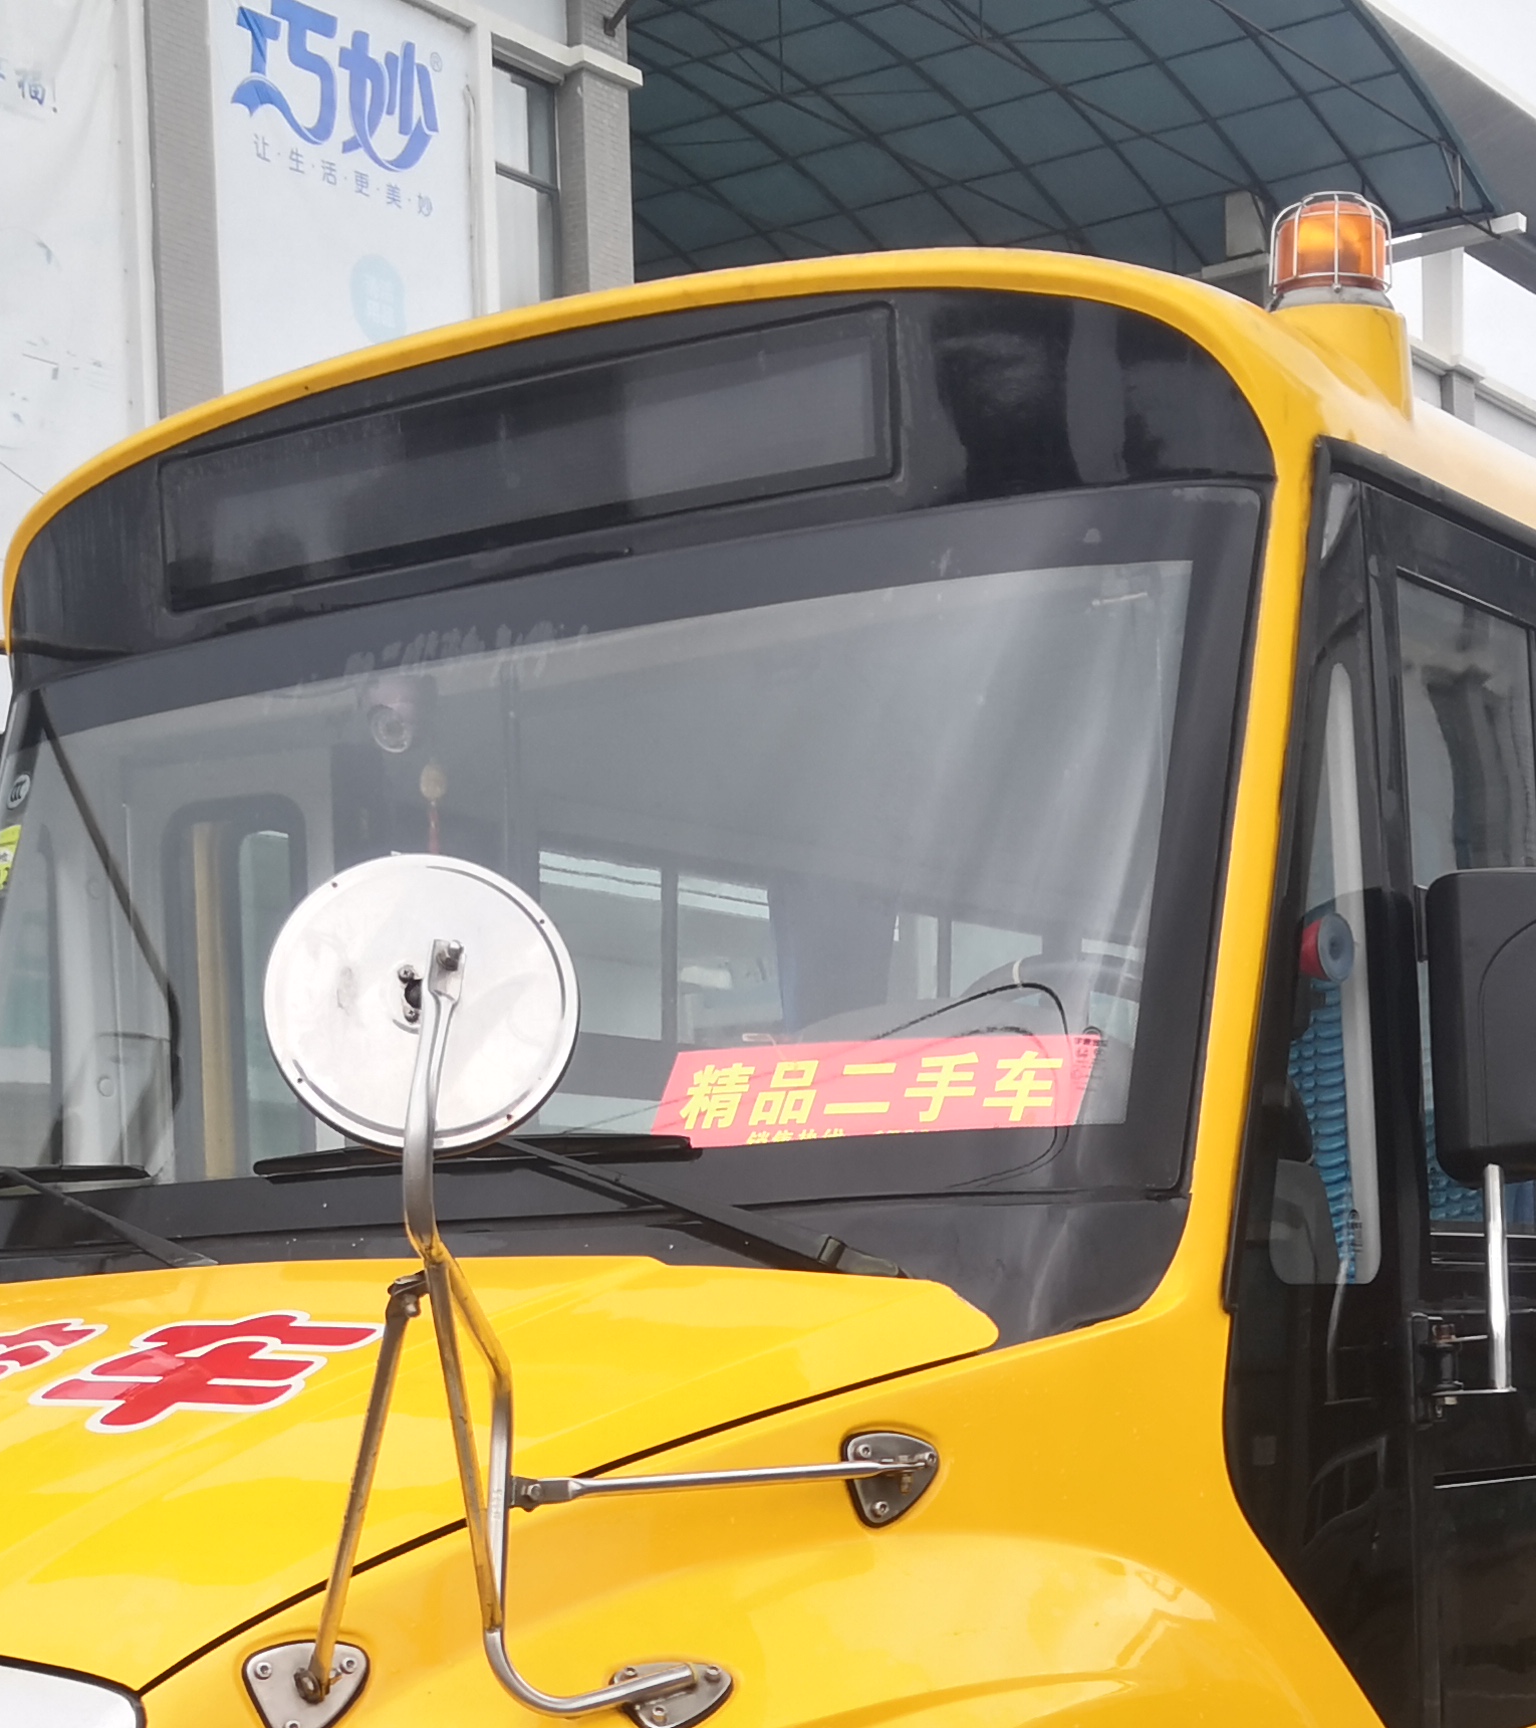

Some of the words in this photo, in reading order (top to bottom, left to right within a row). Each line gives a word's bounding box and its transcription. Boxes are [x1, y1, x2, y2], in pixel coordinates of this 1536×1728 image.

[680, 1051, 1063, 1130] 精品二手车
